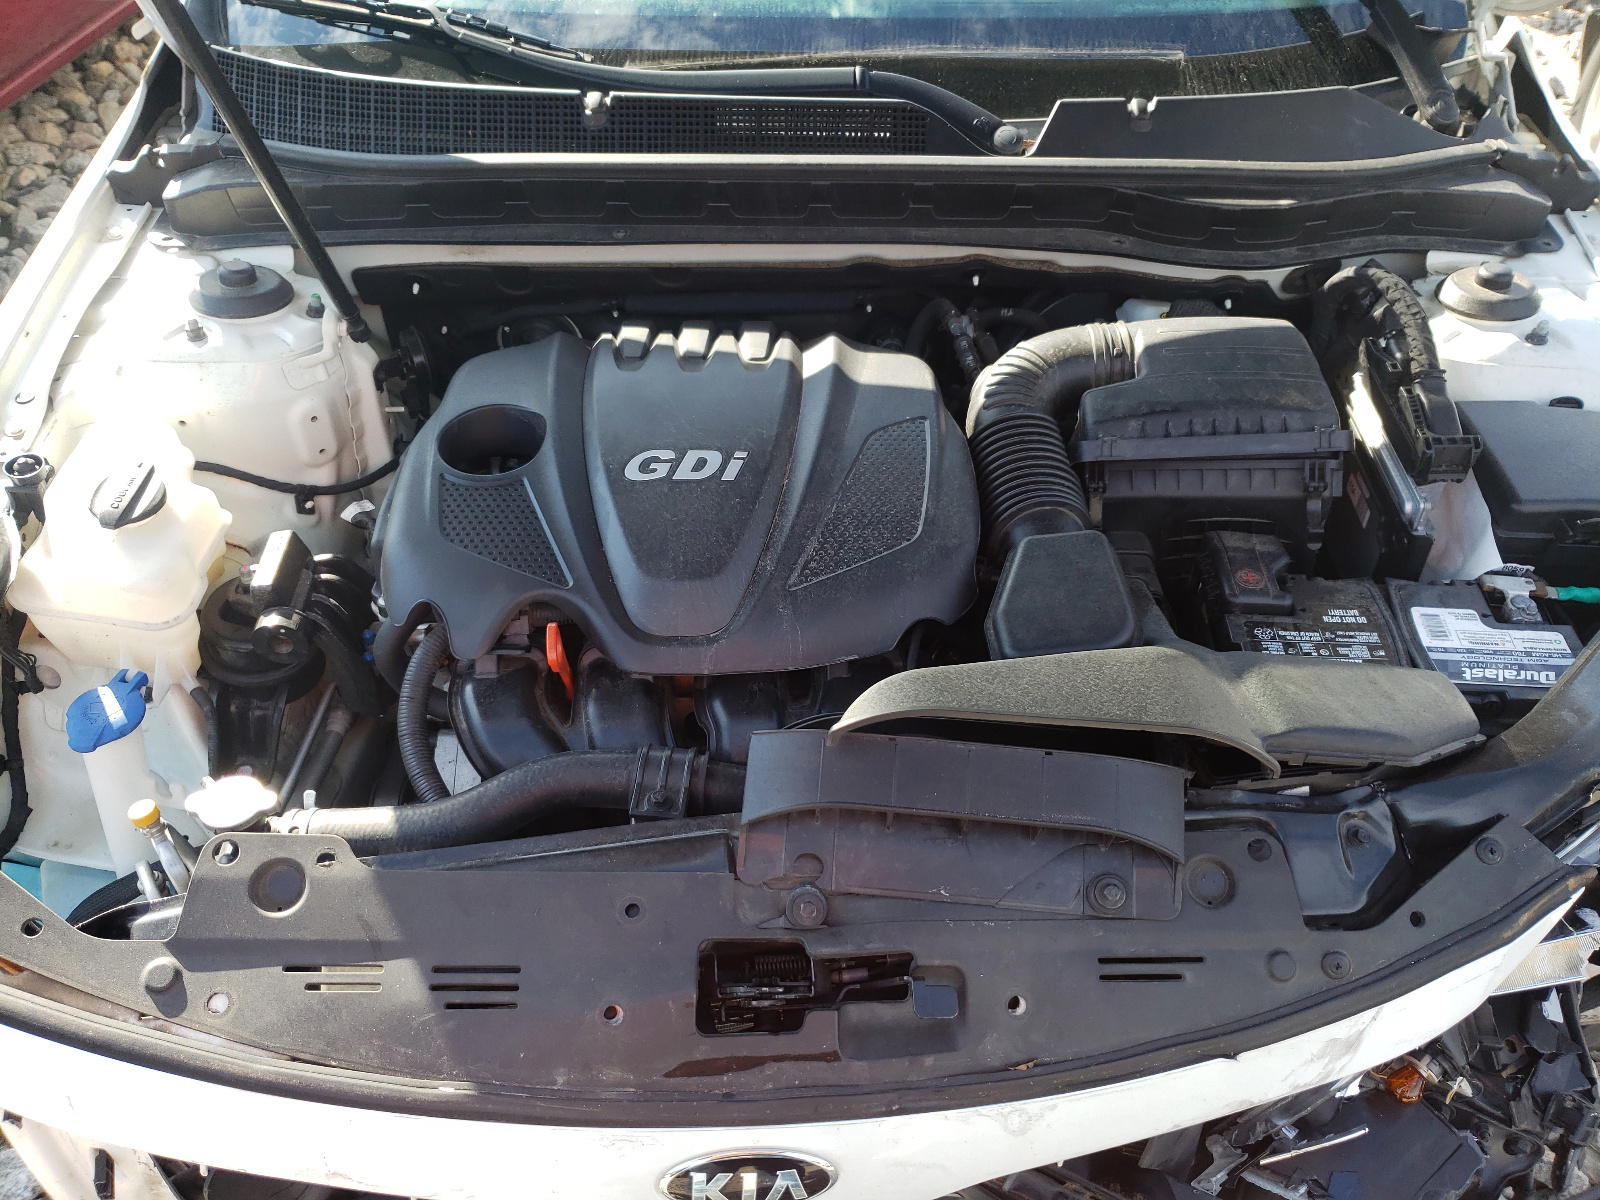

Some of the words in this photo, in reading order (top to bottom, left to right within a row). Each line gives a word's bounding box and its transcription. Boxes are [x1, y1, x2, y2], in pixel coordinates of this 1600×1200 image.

[624, 449, 749, 481] GDi
[1327, 608, 1360, 617] BATTERY!
[1322, 615, 1341, 623] OPEN
[1357, 616, 1368, 624] DO
[1459, 655, 1524, 663] TECHNOLOGY
[1460, 661, 1519, 670] PLATINUM
[1461, 667, 1556, 684] Duralast
[690, 1168, 808, 1200] KIA
